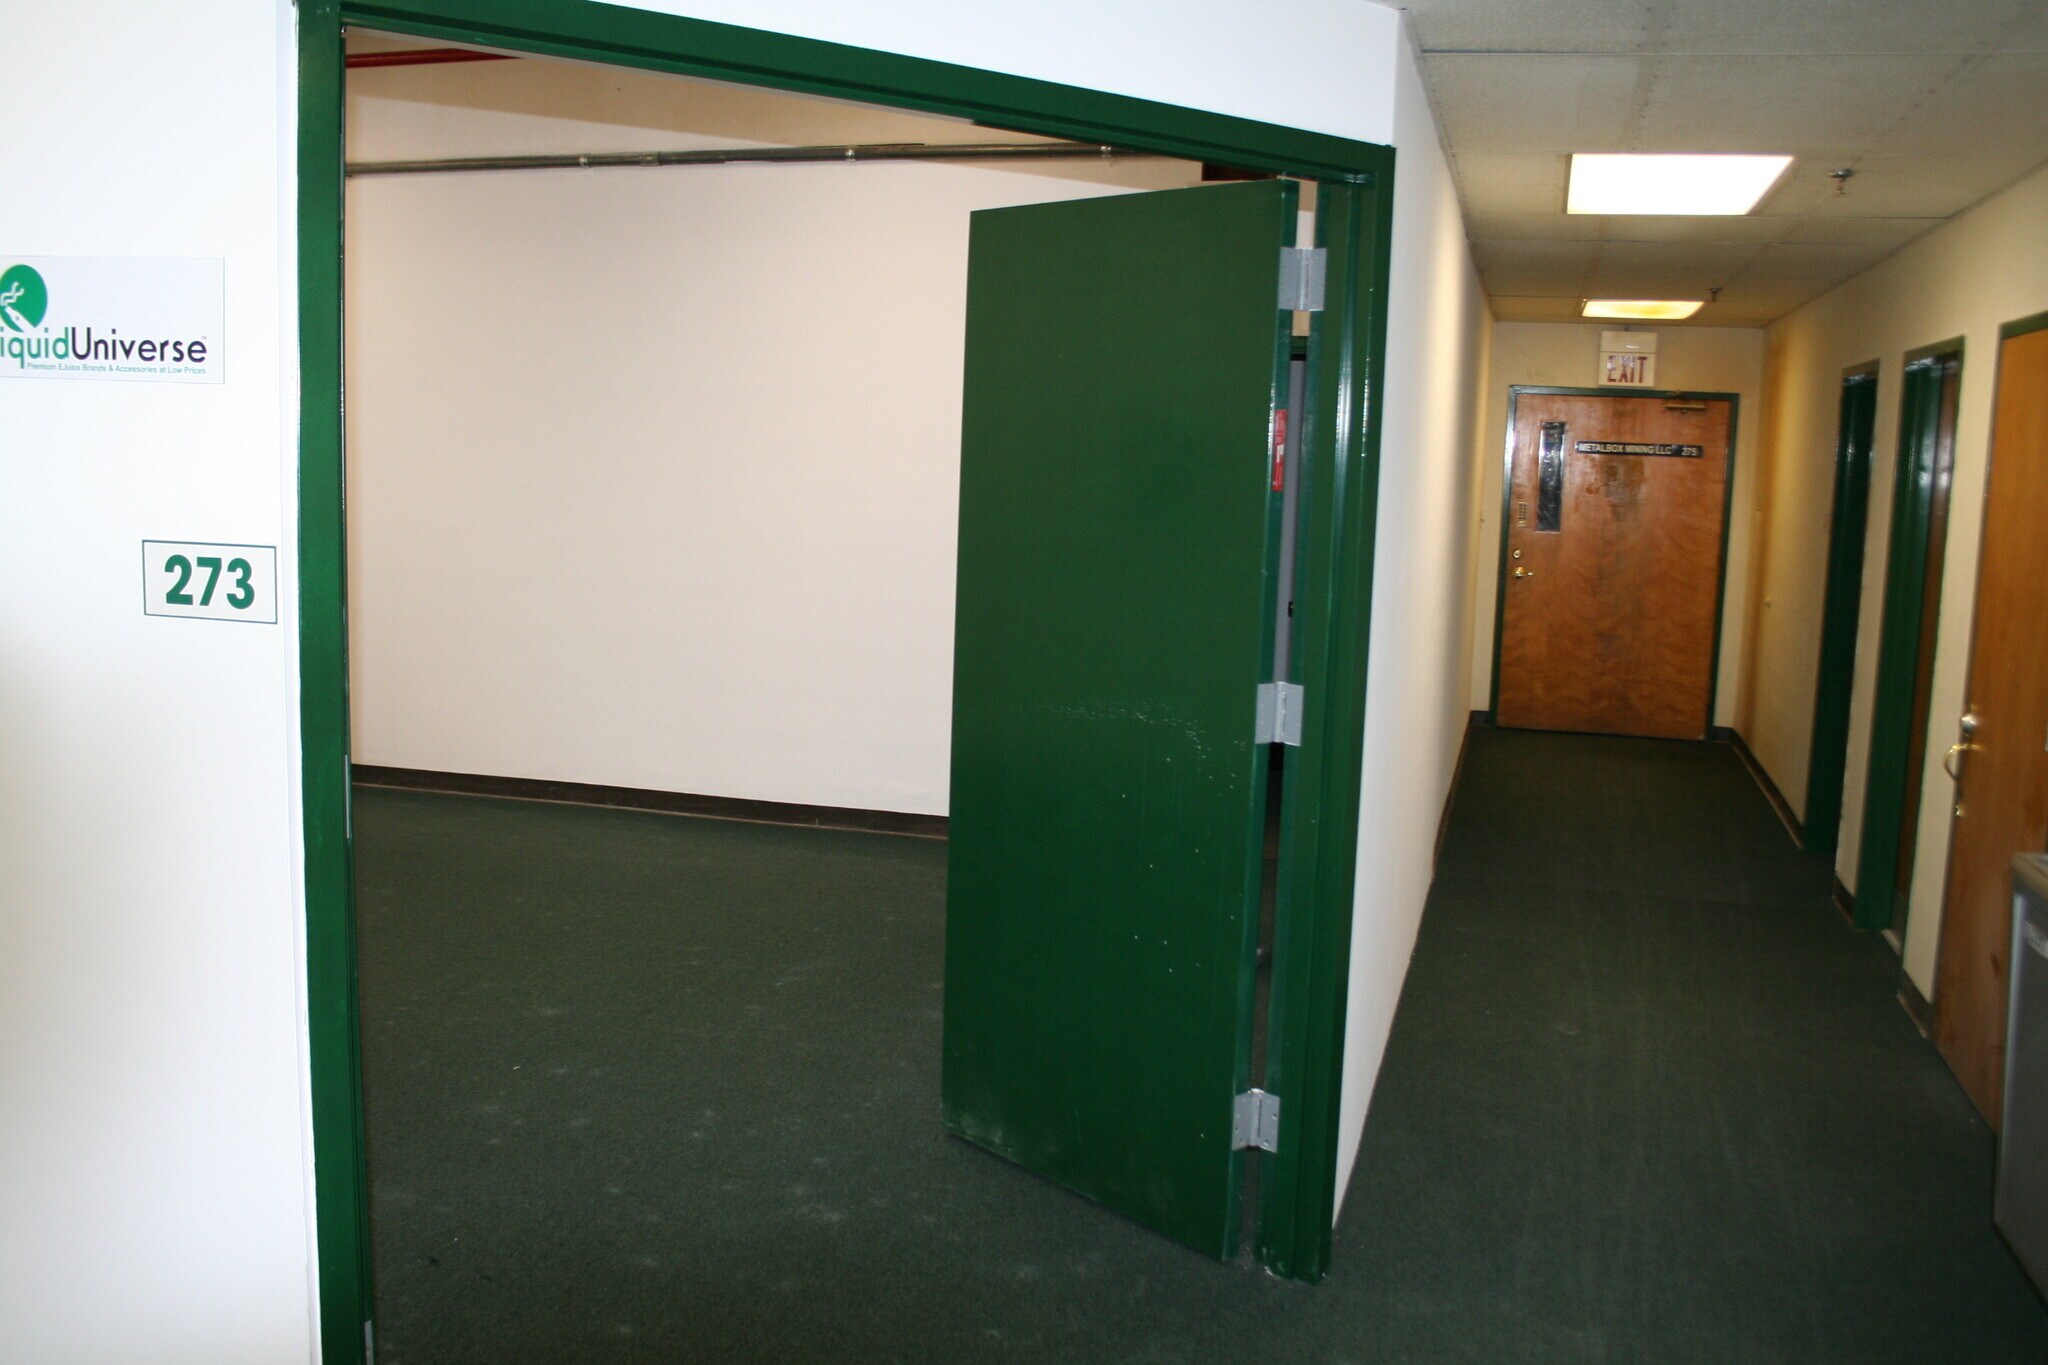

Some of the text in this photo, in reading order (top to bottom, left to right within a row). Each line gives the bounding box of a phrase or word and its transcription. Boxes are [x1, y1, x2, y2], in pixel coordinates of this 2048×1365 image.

[82, 363, 107, 372] Brands
[115, 365, 158, 374] Accessories
[167, 366, 183, 374] Low
[184, 366, 207, 375] Prices
[1607, 355, 1647, 383] EXIT
[1579, 443, 1697, 456] METALBOX MINING LLC 275
[164, 554, 255, 610] 273
